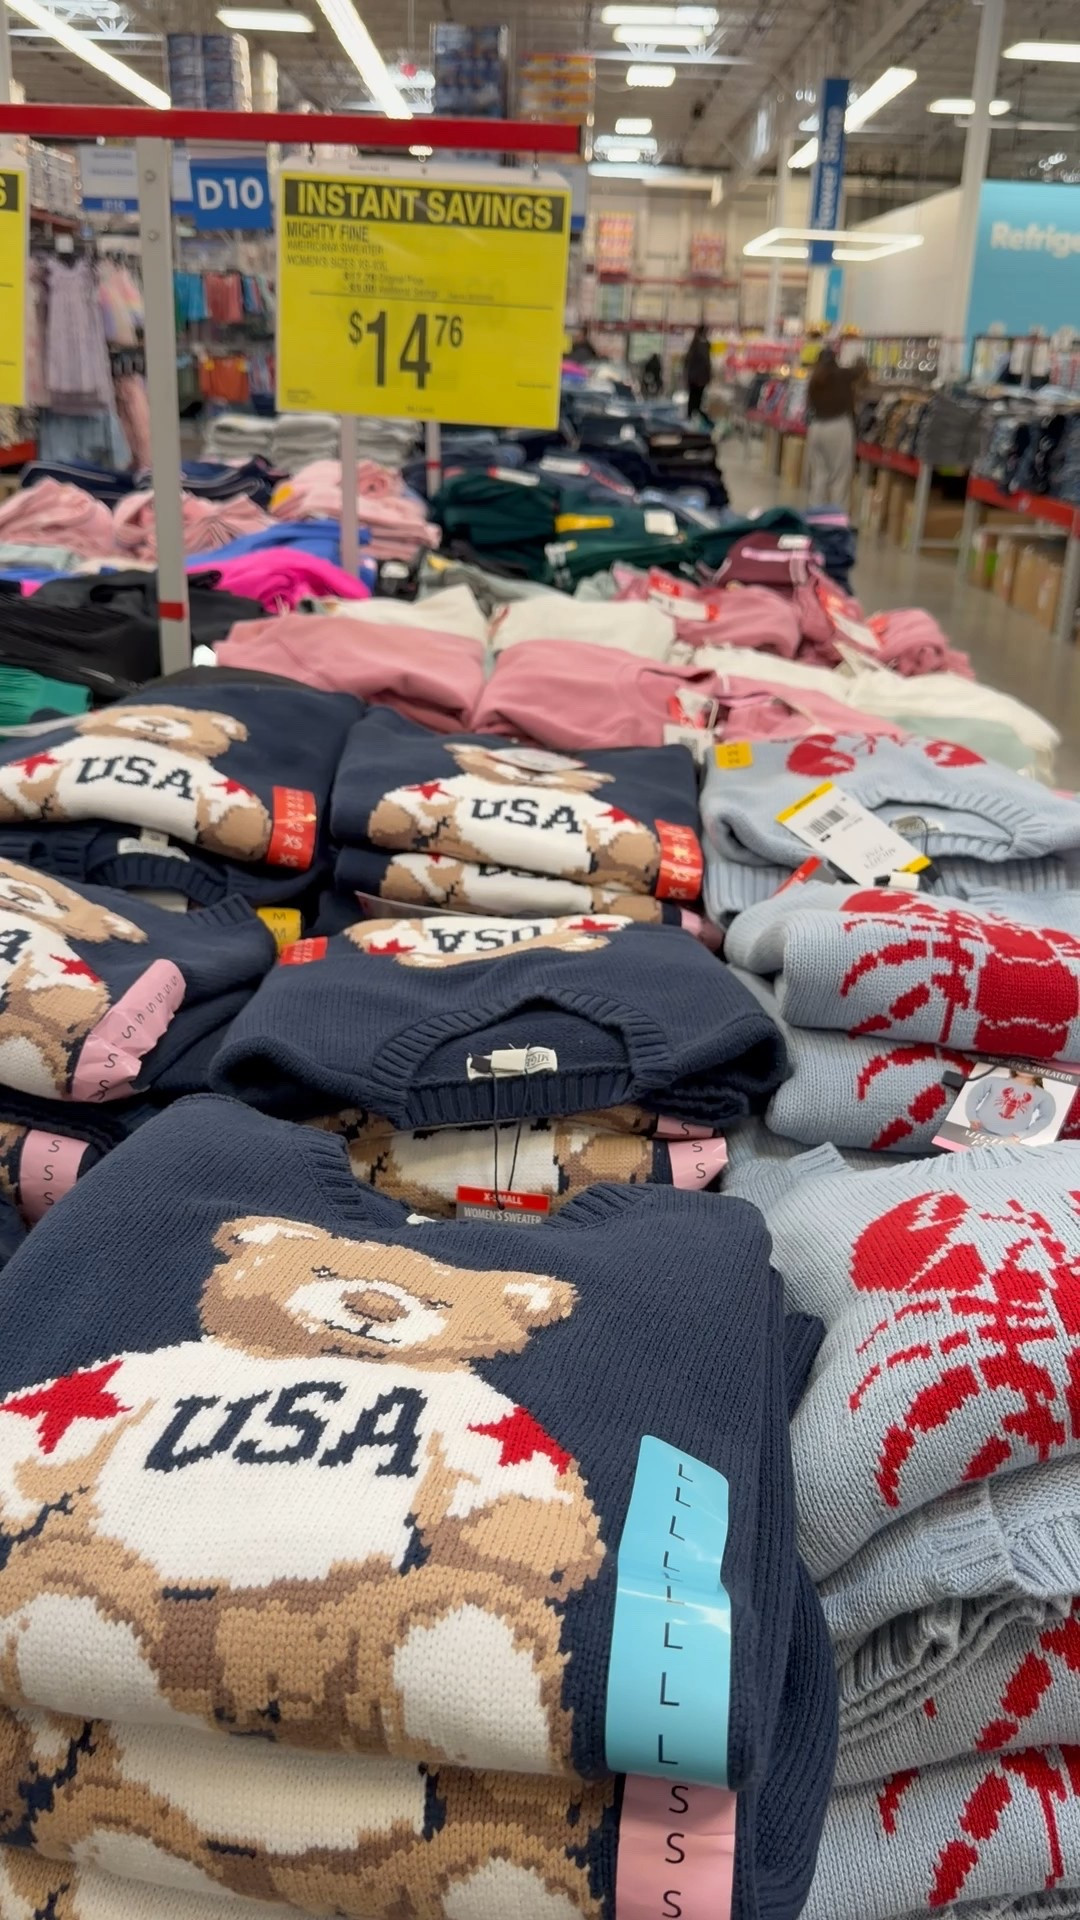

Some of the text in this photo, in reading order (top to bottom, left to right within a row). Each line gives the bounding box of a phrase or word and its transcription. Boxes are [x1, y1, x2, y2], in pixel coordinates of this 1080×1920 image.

[197, 177, 264, 210] D10
[297, 181, 553, 230] INSTANT SAVINGS
[287, 222, 369, 243] MIGHTY FINE
[75, 755, 194, 800] USA
[472, 798, 583, 834] USA
[283, 834, 303, 850] XS
[279, 853, 298, 867] XS
[670, 867, 691, 882] XS
[273, 912, 286, 920] M
[428, 926, 542, 953] USA
[155, 992, 165, 1003] S
[146, 1002, 157, 1013] S
[134, 1013, 145, 1024] S
[121, 1025, 136, 1039] S
[104, 1053, 118, 1068] S
[1031, 1065, 1073, 1082] SWEATER
[48, 1140, 62, 1153] S
[692, 1141, 703, 1152] S
[43, 1165, 54, 1181] S
[696, 1163, 706, 1179] S
[44, 1192, 55, 1206] S
[463, 1207, 543, 1225] WOMEN'S SWEATER
[143, 1379, 429, 1477] USA
[678, 1463, 693, 1482] L
[675, 1486, 691, 1507] L
[669, 1515, 685, 1541] L
[663, 1551, 680, 1572] L
[664, 1622, 683, 1649] L
[660, 1672, 679, 1706] L
[658, 1734, 678, 1765] L
[668, 1785, 689, 1814] S
[665, 1832, 685, 1864] S
[662, 1890, 682, 1919] S
